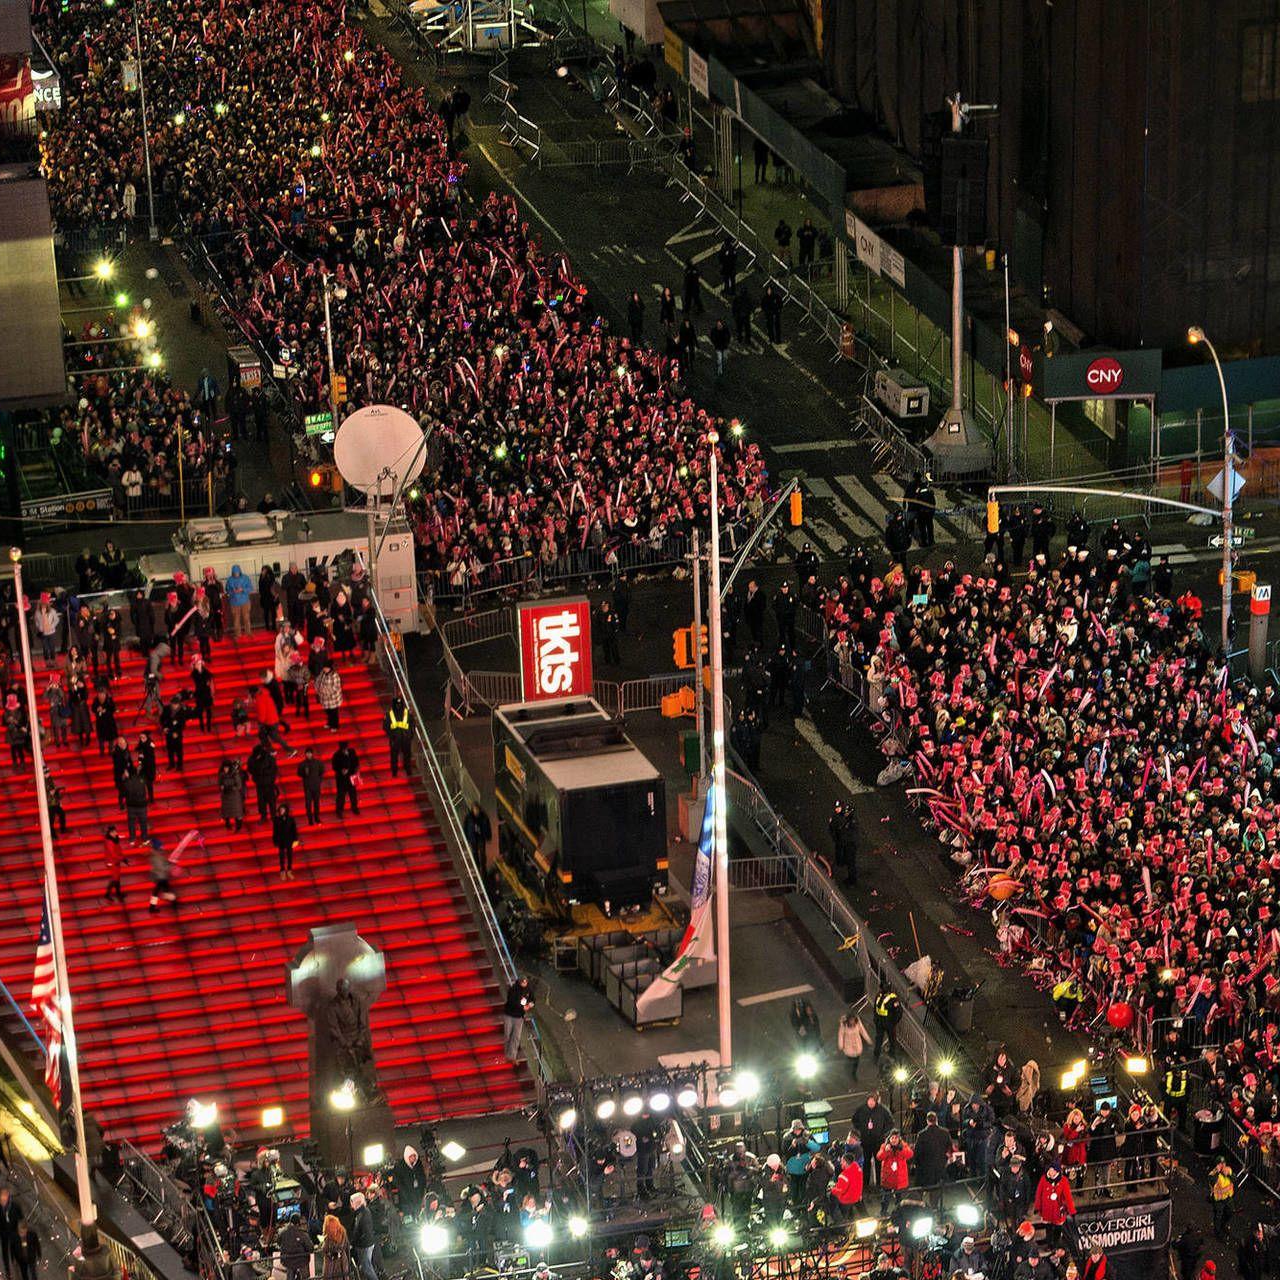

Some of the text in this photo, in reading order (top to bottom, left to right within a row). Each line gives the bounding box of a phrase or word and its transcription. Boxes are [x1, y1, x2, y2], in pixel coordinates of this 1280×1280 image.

[1087, 368, 1122, 384] CNY
[538, 610, 580, 694] tkts
[1077, 1213, 1155, 1235] COVERGIRL
[1078, 1225, 1155, 1251] COSMOPOLITAN
